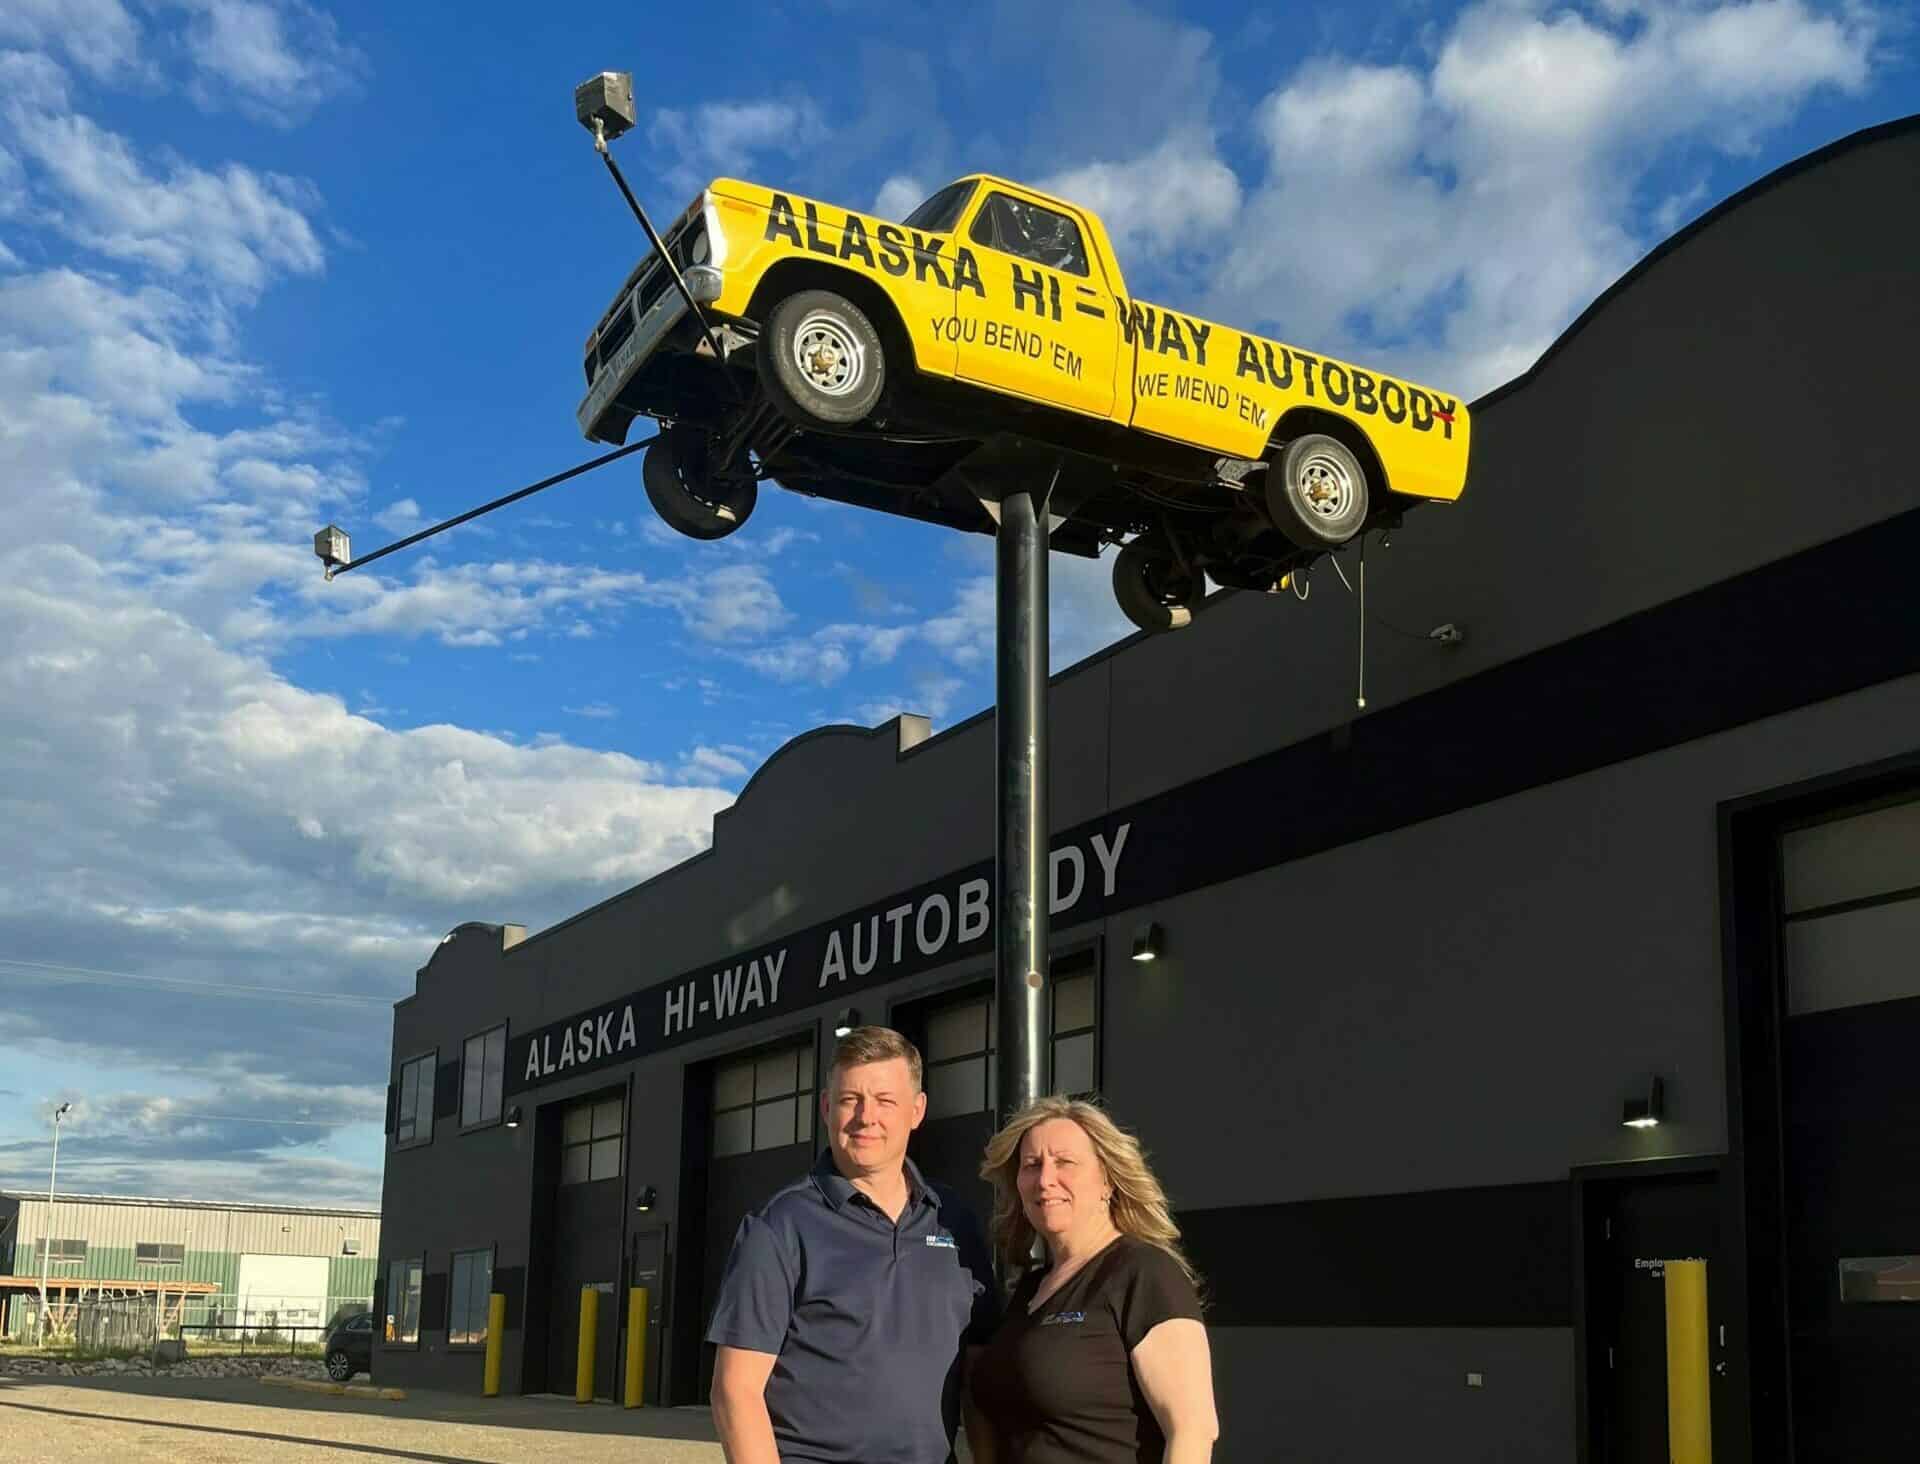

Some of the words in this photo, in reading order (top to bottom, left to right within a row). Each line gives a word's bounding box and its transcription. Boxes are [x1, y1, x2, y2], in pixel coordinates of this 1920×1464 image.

[764, 192, 986, 298] ALASKA
[1236, 335, 1456, 440] AUTOBODY
[931, 316, 977, 344] YOU
[985, 320, 1042, 358] BEND
[1049, 341, 1083, 380] 'EM
[1137, 373, 1169, 397] WE
[1174, 375, 1229, 410] MEND
[1236, 391, 1266, 430] 'EM
[525, 1005, 636, 1081] ALASKA
[664, 949, 787, 1036] HI-WAY
[819, 823, 1130, 988] AUTOBDY
